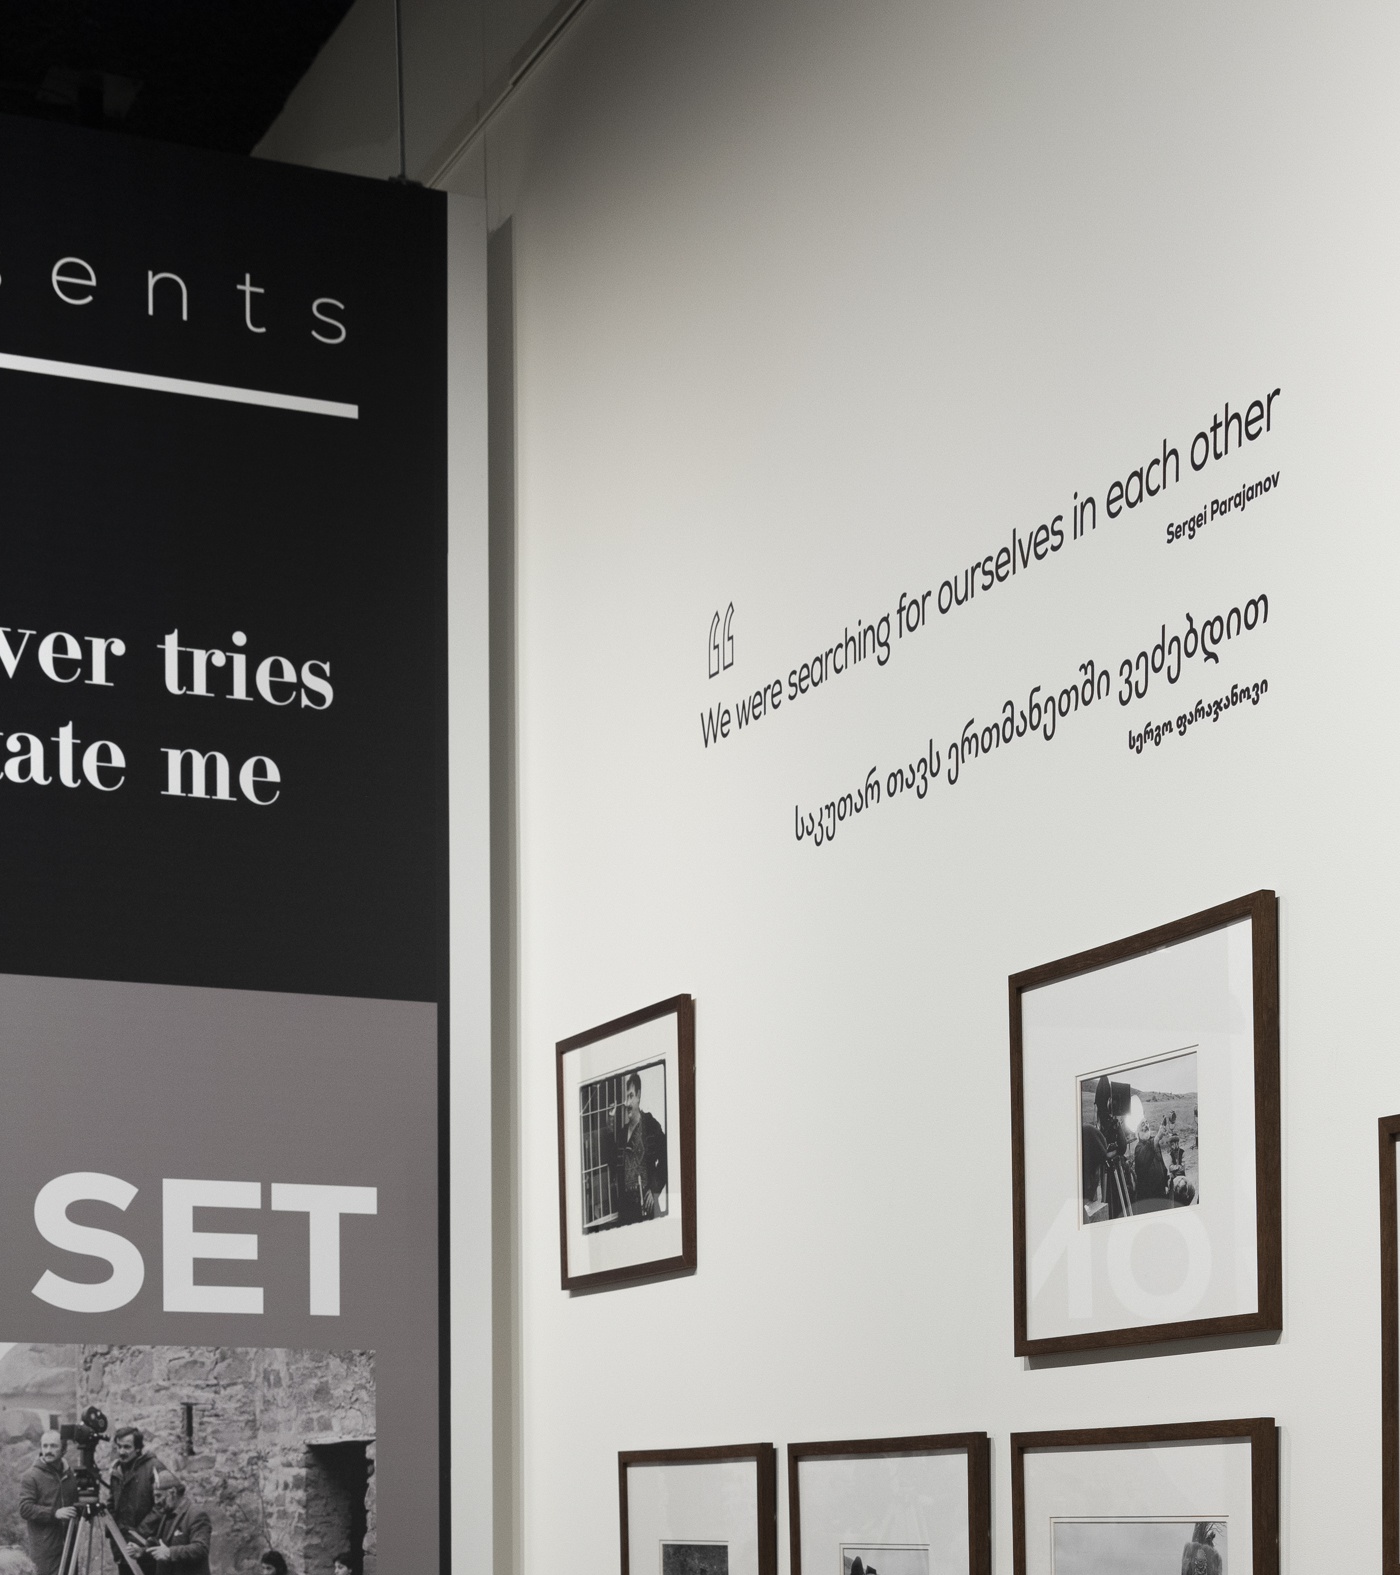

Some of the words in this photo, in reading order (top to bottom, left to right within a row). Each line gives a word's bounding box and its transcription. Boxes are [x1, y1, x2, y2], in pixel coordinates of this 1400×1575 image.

[1166, 505, 1207, 544] Sergei
[1211, 471, 1280, 521] Parajanov
[700, 702, 731, 748] We
[736, 679, 782, 729] were
[788, 613, 890, 701] searching
[896, 590, 932, 638] for
[938, 515, 1064, 614] ourselves
[1073, 491, 1096, 540] in
[1106, 439, 1179, 519] each
[1190, 388, 1281, 471] other
[158, 629, 333, 709] tries
[795, 766, 880, 847] საკუთარ
[887, 739, 941, 799] თავს
[947, 660, 1110, 785] ერთმანეთში
[1118, 594, 1268, 706] ვეძებდით
[1128, 720, 1173, 754] სერგო
[1176, 679, 1268, 736] ფარაჯანოვი
[161, 749, 280, 805] me
[32, 1172, 377, 1316] SET
